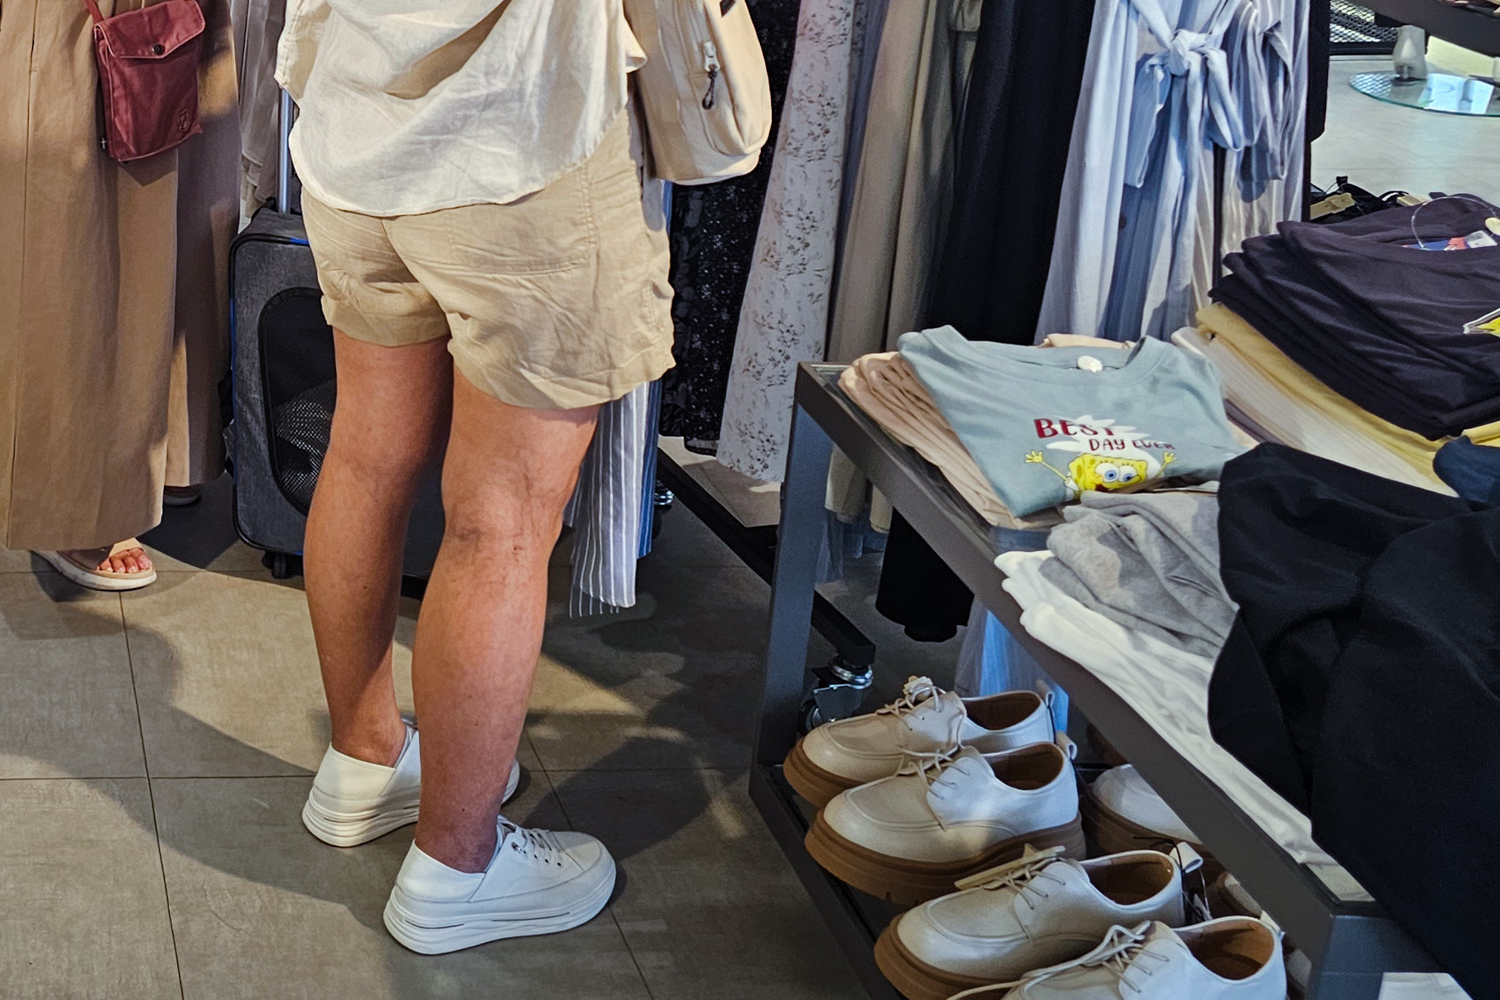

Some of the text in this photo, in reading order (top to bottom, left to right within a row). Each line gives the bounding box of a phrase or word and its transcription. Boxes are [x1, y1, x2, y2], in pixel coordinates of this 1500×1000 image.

[1033, 417, 1116, 439] BEST
[1088, 438, 1176, 451] DAY EVER
